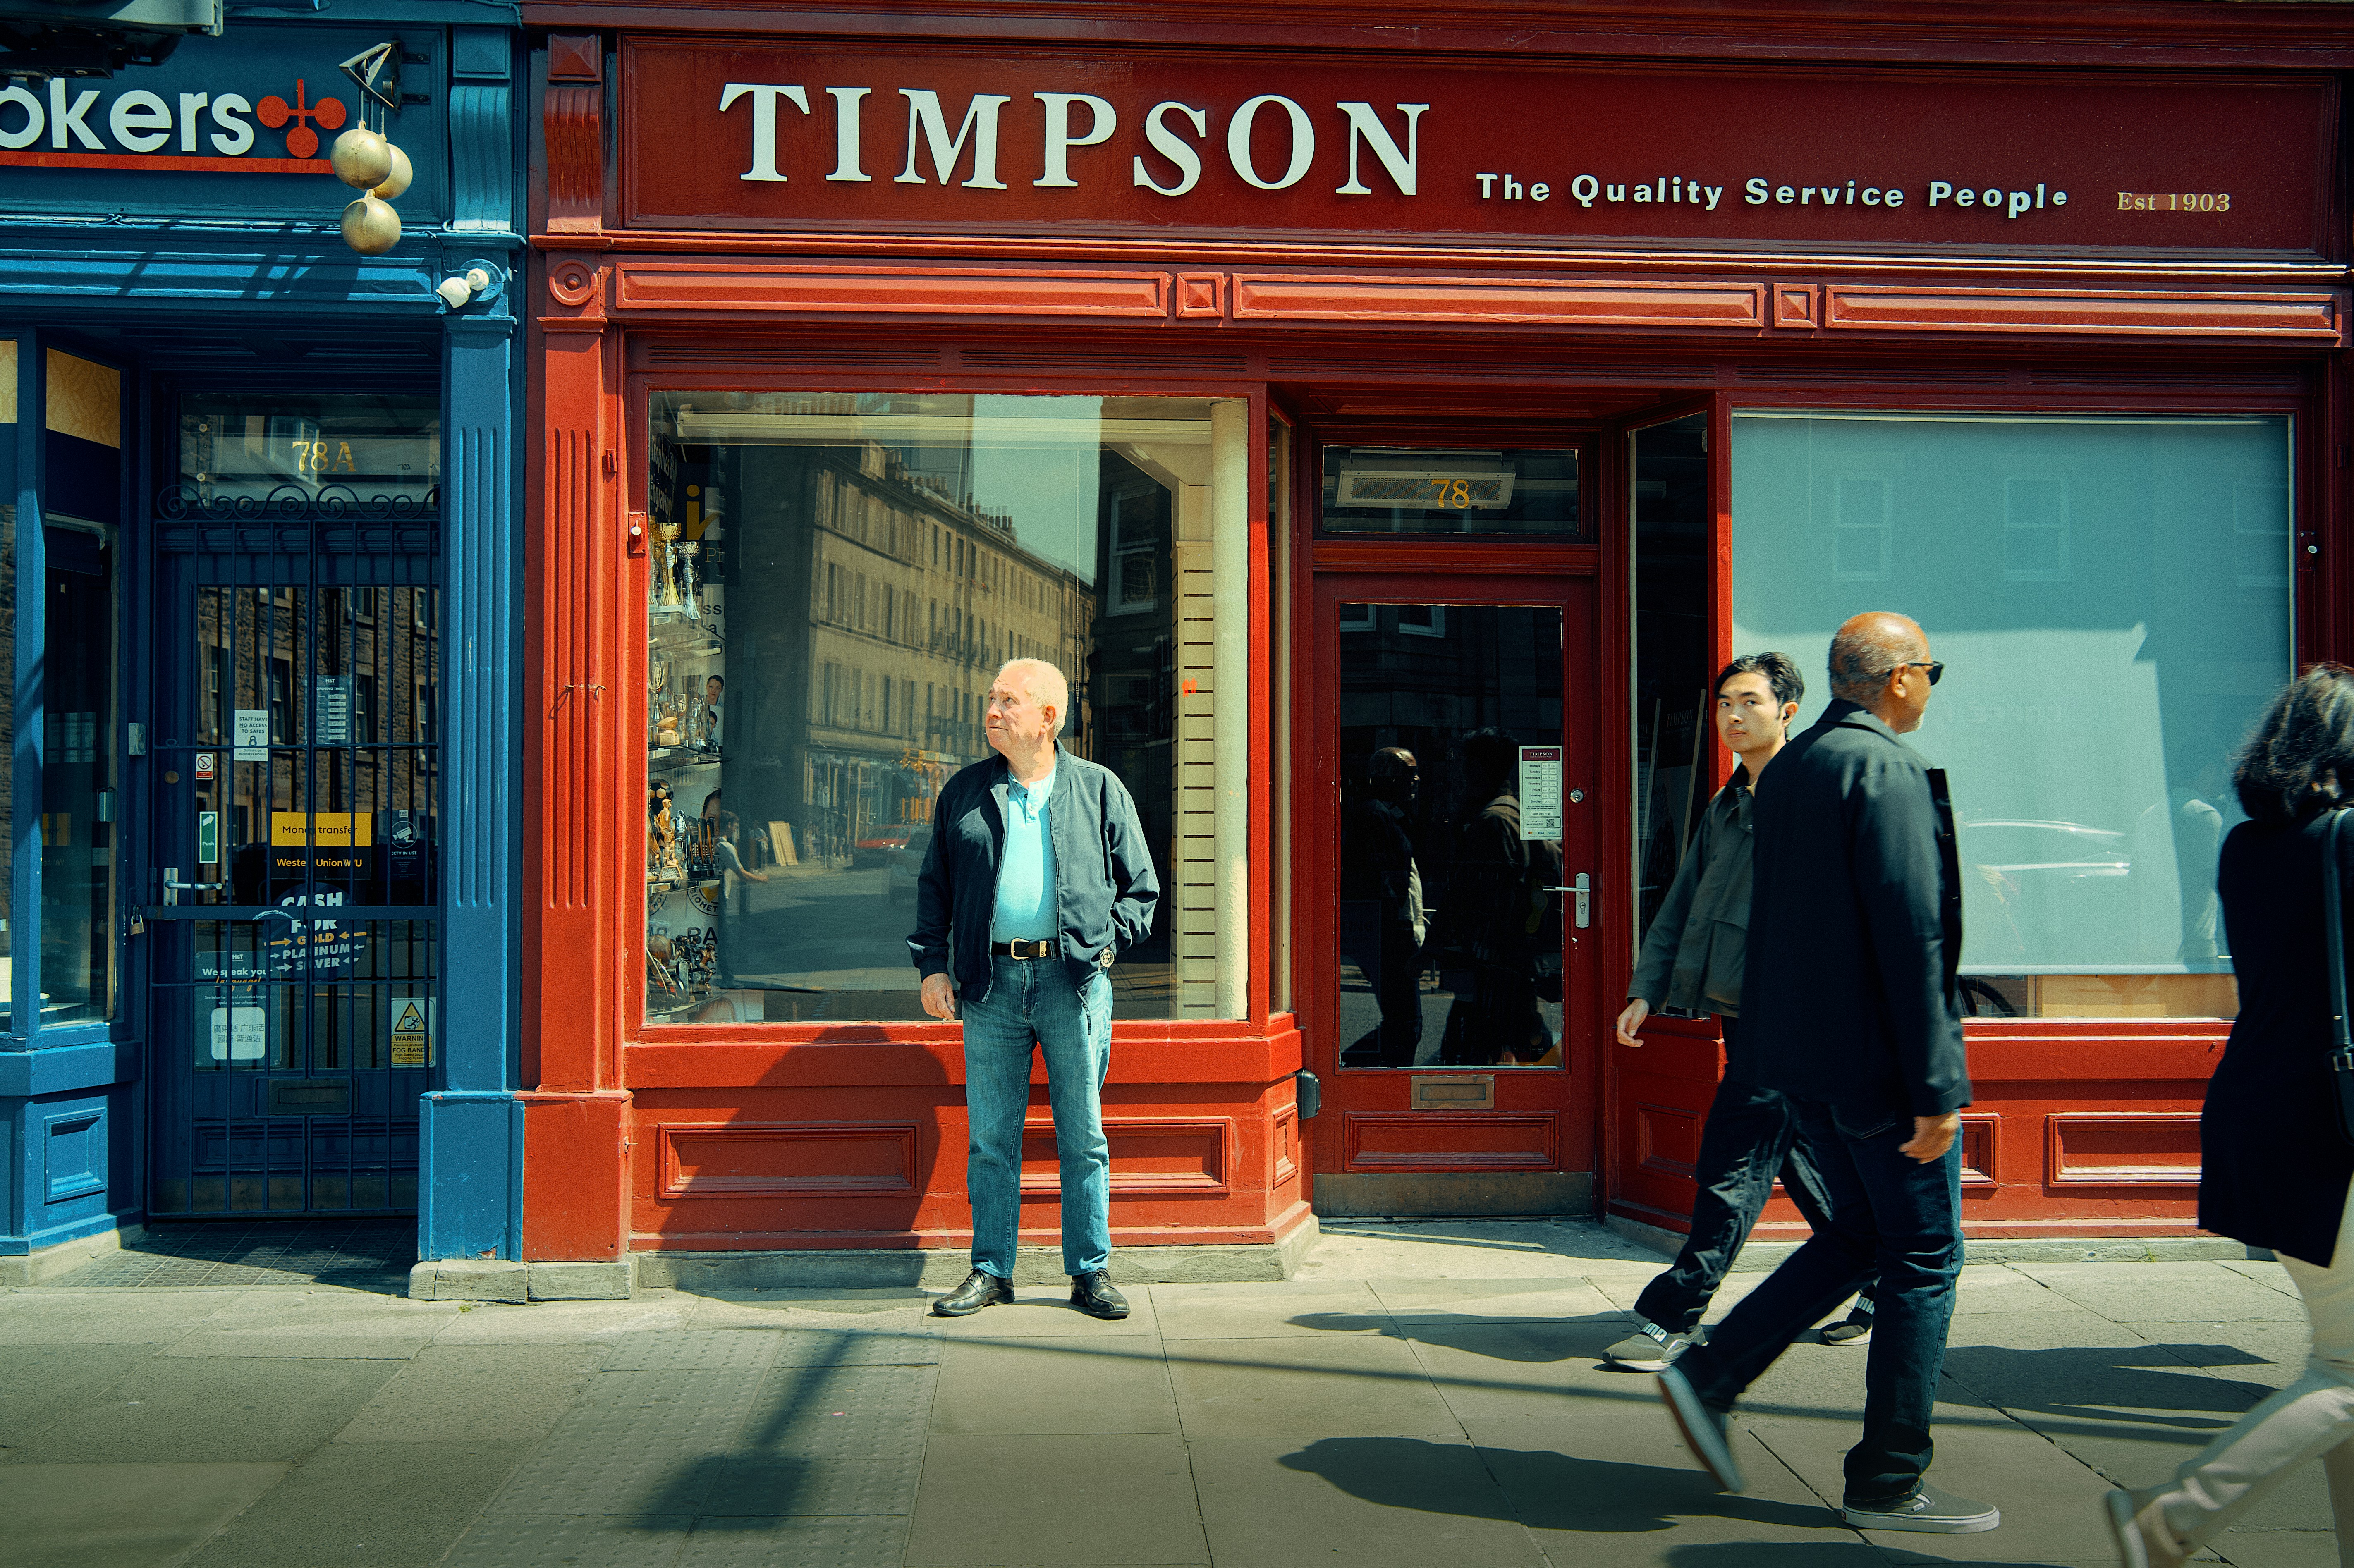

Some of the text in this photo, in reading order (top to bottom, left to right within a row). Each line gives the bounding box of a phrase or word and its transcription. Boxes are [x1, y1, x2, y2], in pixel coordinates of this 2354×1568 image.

[719, 84, 1430, 196] TIMPSON
[1477, 174, 2067, 219] The Quality Service People
[2117, 192, 2230, 212] Est 1903
[1431, 479, 1469, 508] 78
[277, 858, 309, 867] Weste
[316, 858, 342, 867] Union
[283, 943, 350, 959] PLAINUM
[296, 957, 340, 971] SVER
[240, 1024, 265, 1032] 广东话
